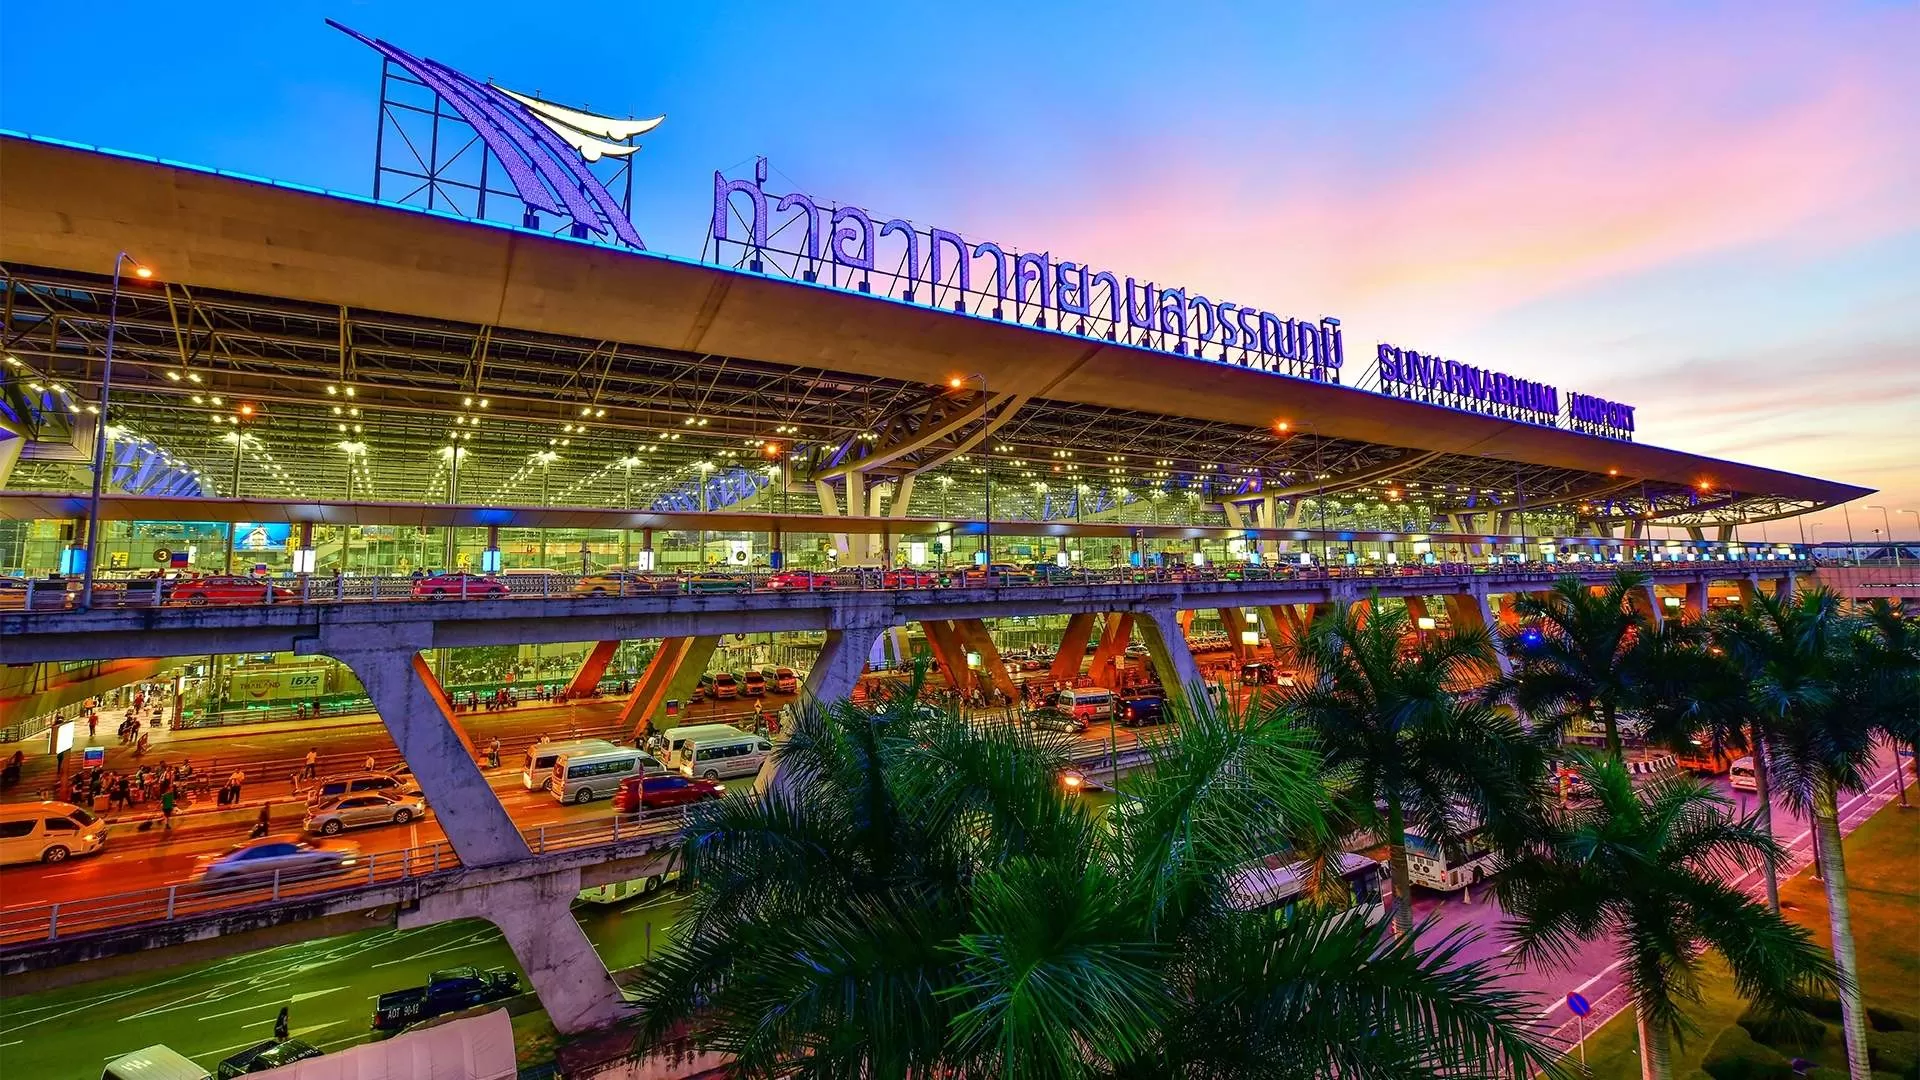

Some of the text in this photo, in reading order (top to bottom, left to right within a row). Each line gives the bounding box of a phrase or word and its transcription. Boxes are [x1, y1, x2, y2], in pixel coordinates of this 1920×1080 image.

[713, 157, 1344, 381] ท่าอากาศยานสุวรรณภูมิ
[1378, 343, 1636, 432] SUVARNABHUMI AIRPORT
[158, 551, 168, 560] 3
[290, 675, 319, 686] 1672
